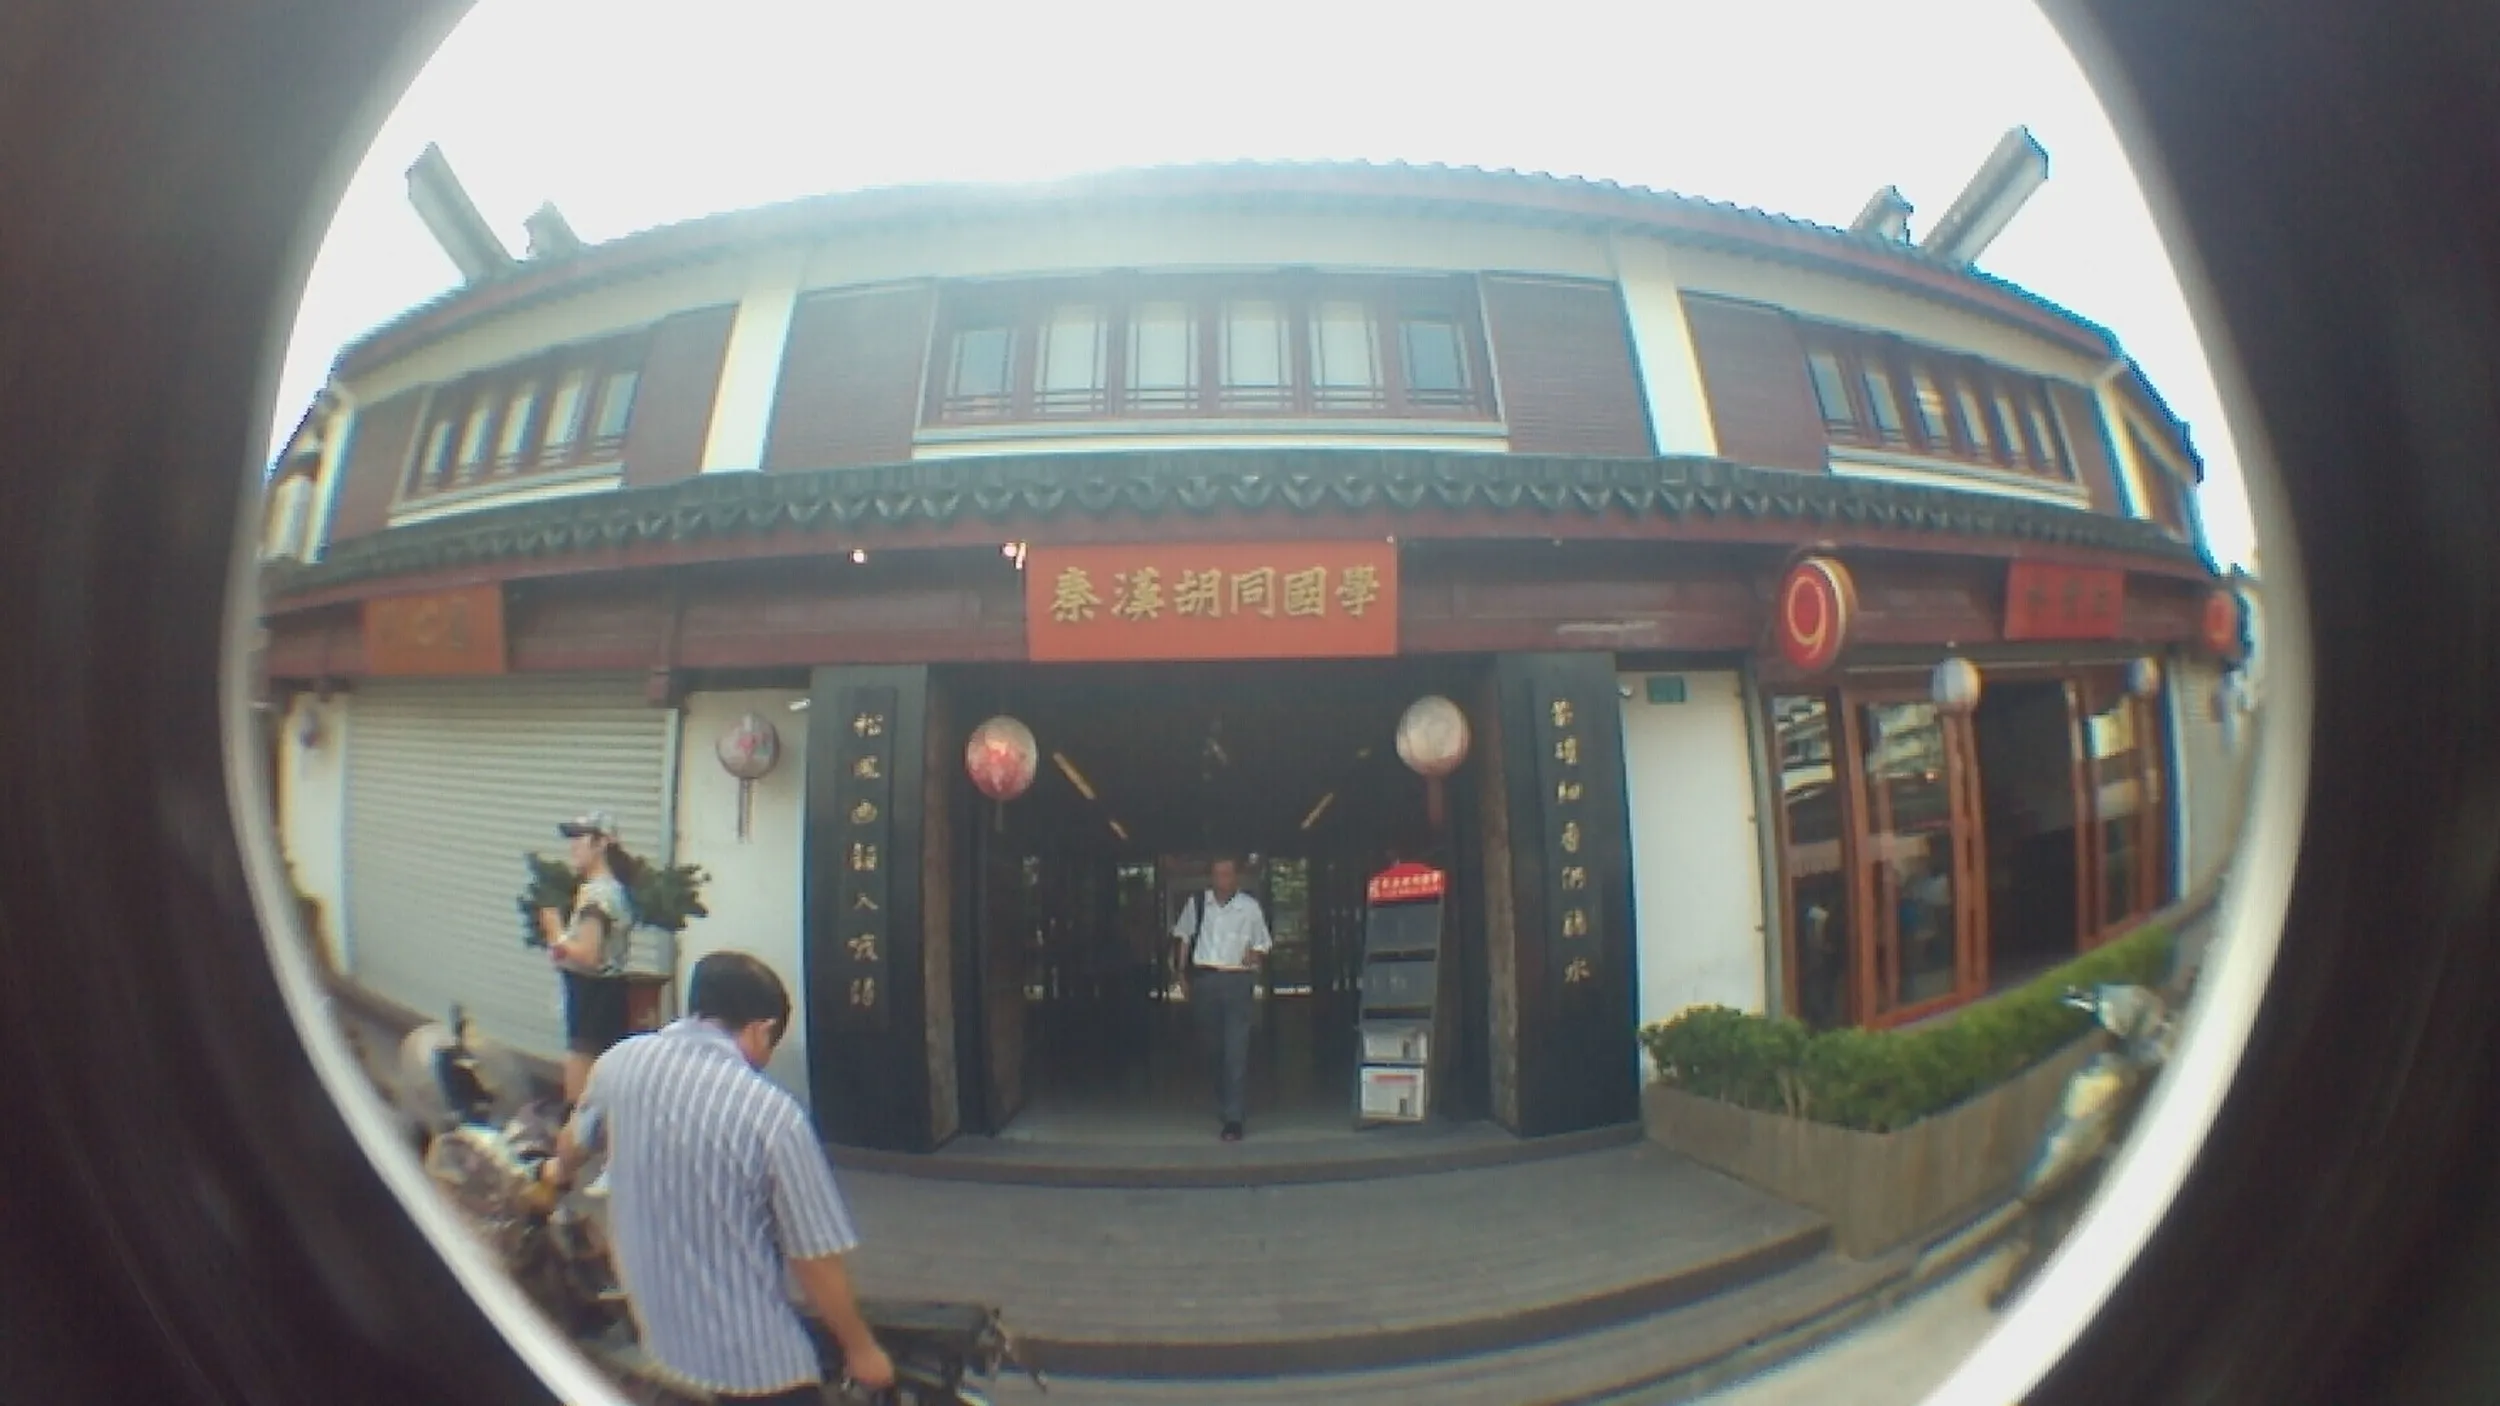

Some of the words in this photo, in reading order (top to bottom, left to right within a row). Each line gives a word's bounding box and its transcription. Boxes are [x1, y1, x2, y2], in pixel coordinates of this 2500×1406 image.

[1049, 565, 1381, 623] 秦漢胡同國學
